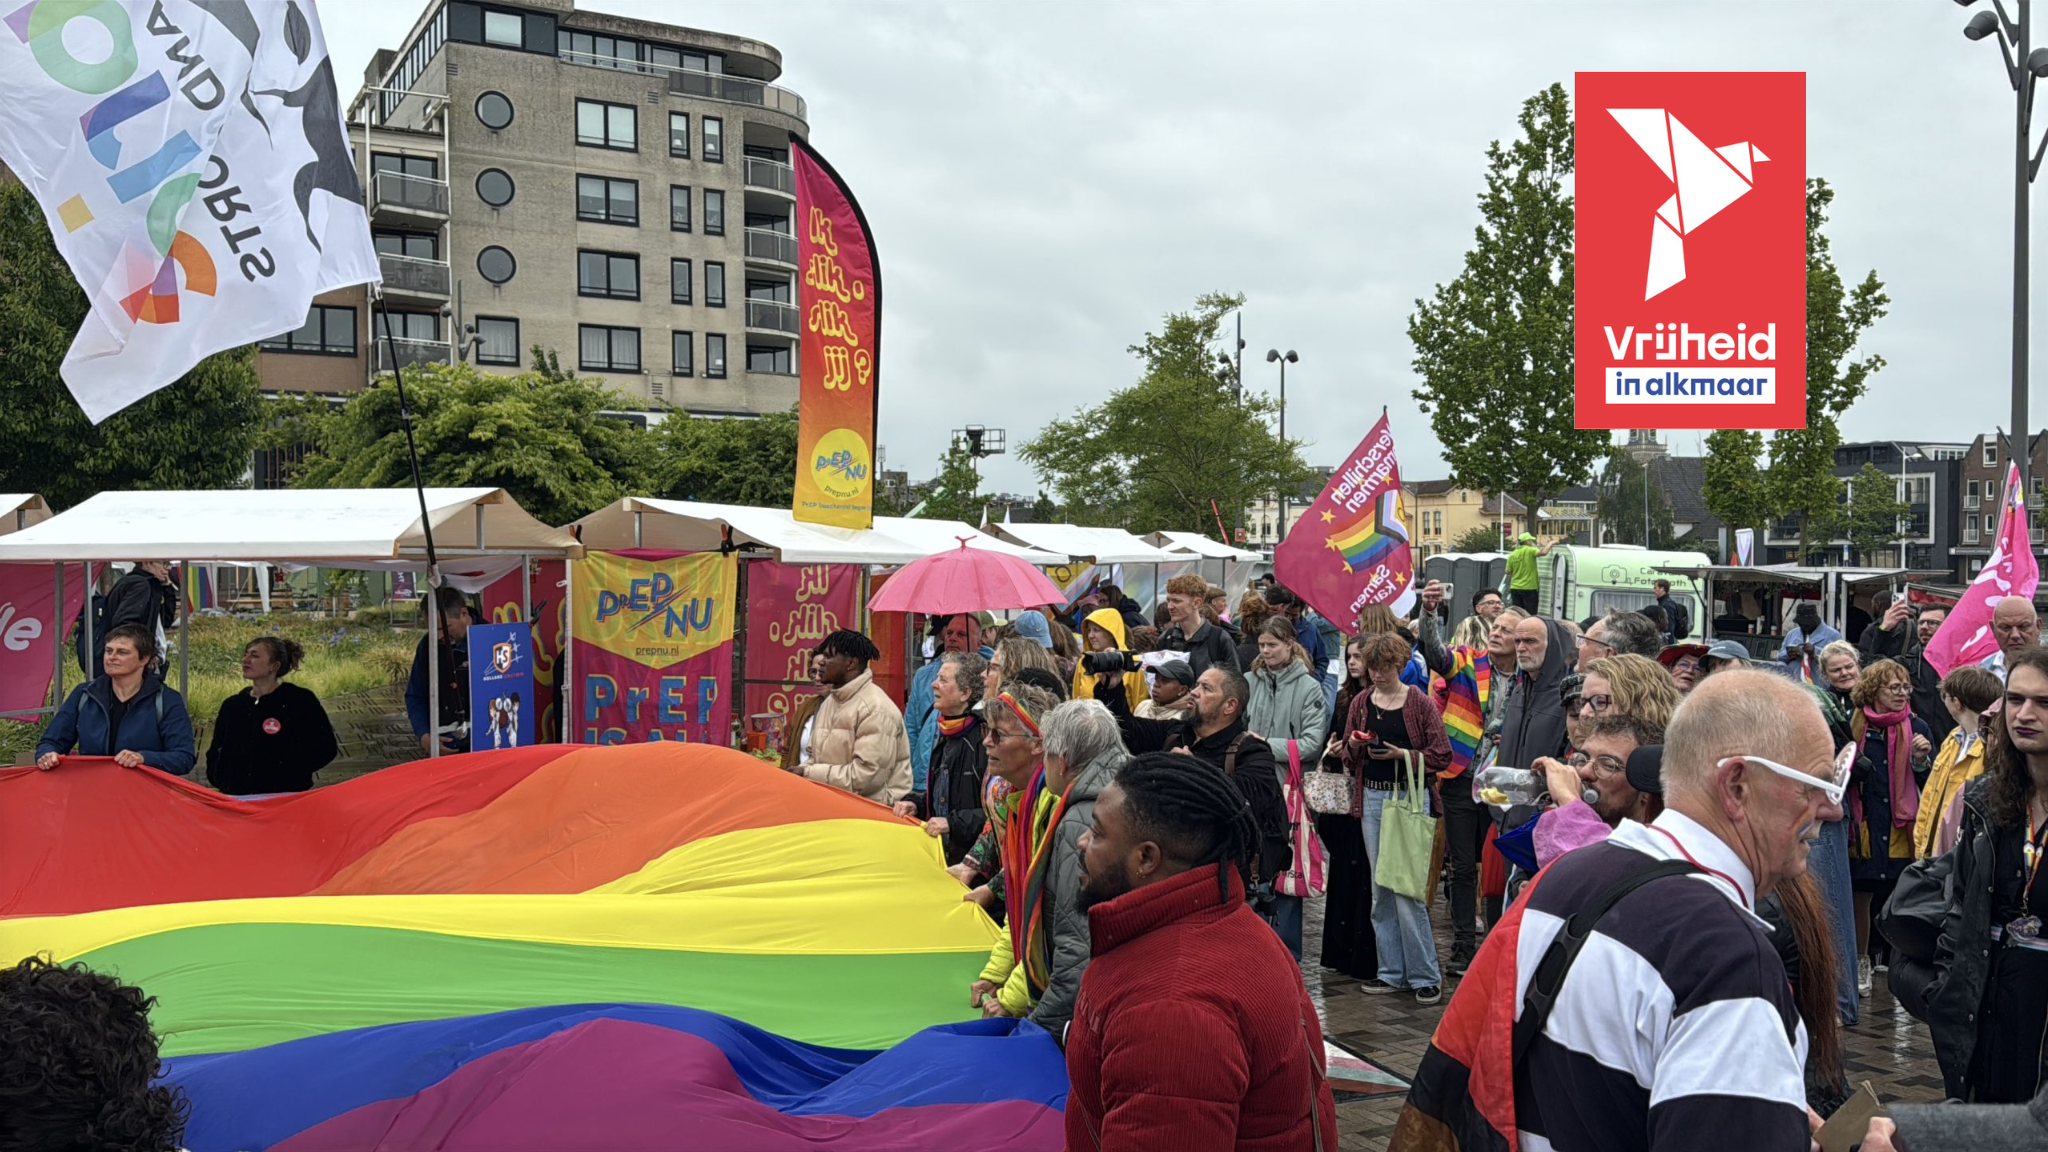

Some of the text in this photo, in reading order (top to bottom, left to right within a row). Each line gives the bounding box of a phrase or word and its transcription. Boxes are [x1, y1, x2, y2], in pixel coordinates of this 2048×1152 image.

[845, 463, 868, 481] NU
[824, 485, 859, 497] prepnu.nl
[664, 597, 714, 638] NU
[496, 649, 509, 665] HS
[635, 646, 680, 656] prepnu.nl
[585, 674, 718, 724] PrEP
